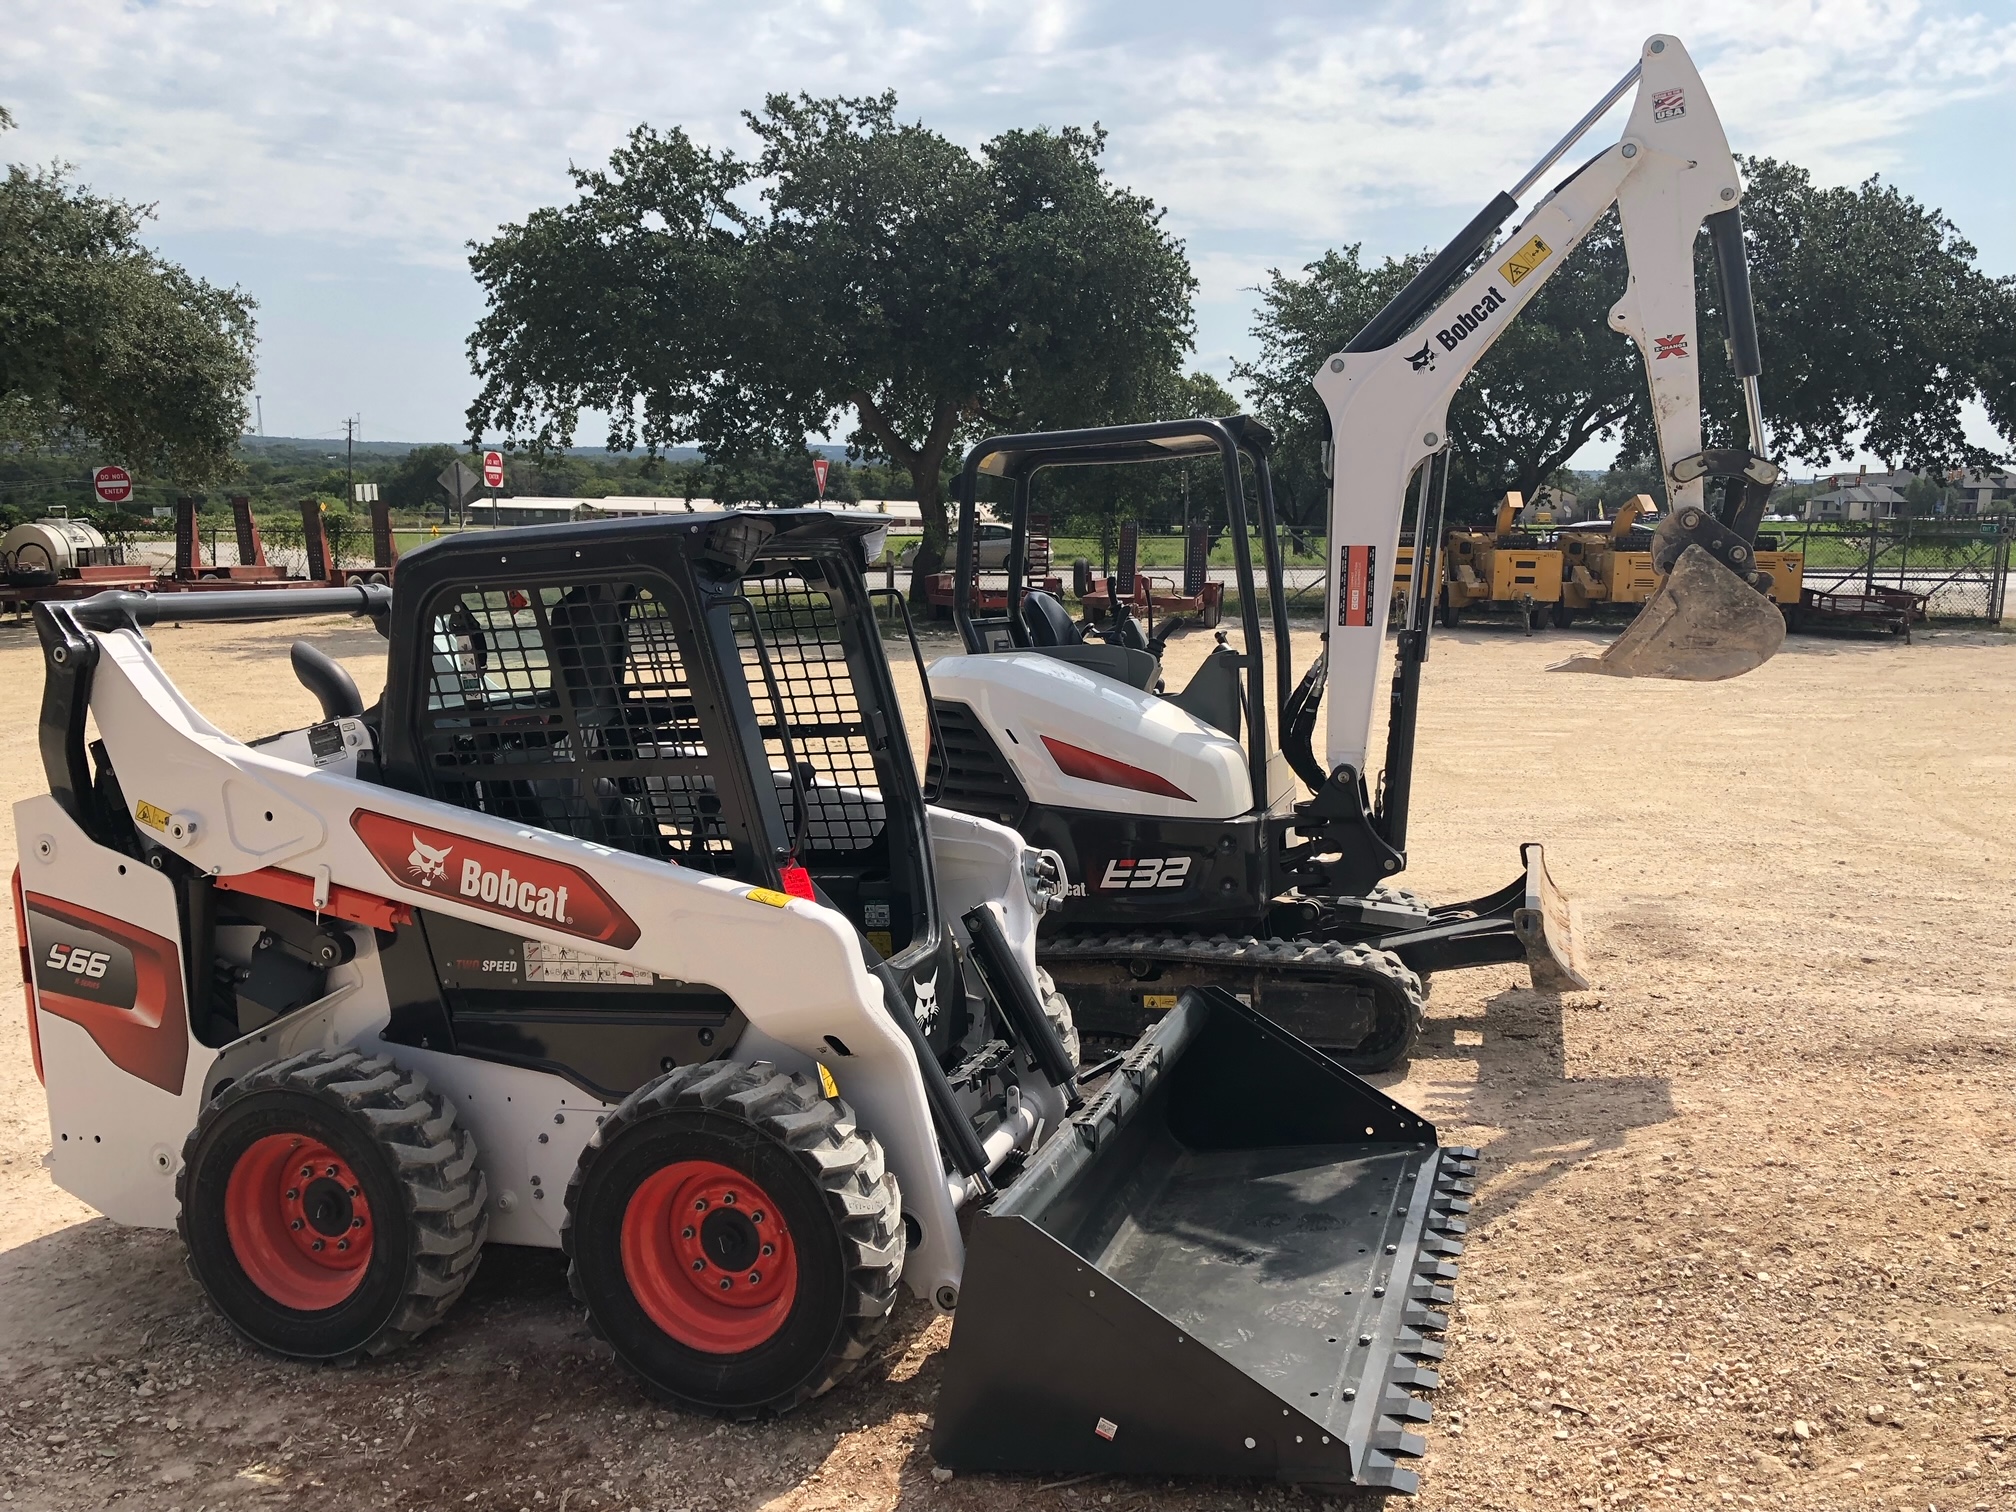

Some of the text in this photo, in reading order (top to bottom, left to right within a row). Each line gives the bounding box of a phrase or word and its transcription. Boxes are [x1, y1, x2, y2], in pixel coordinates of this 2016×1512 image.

[1656, 107, 1684, 119] USA
[1436, 286, 1506, 352] Bobcat
[1654, 342, 1687, 352] X-CHANGE
[1100, 857, 1192, 889] E32
[460, 858, 568, 923] Bobcat
[46, 943, 111, 978] S66
[456, 959, 518, 973] TWO SPEED
